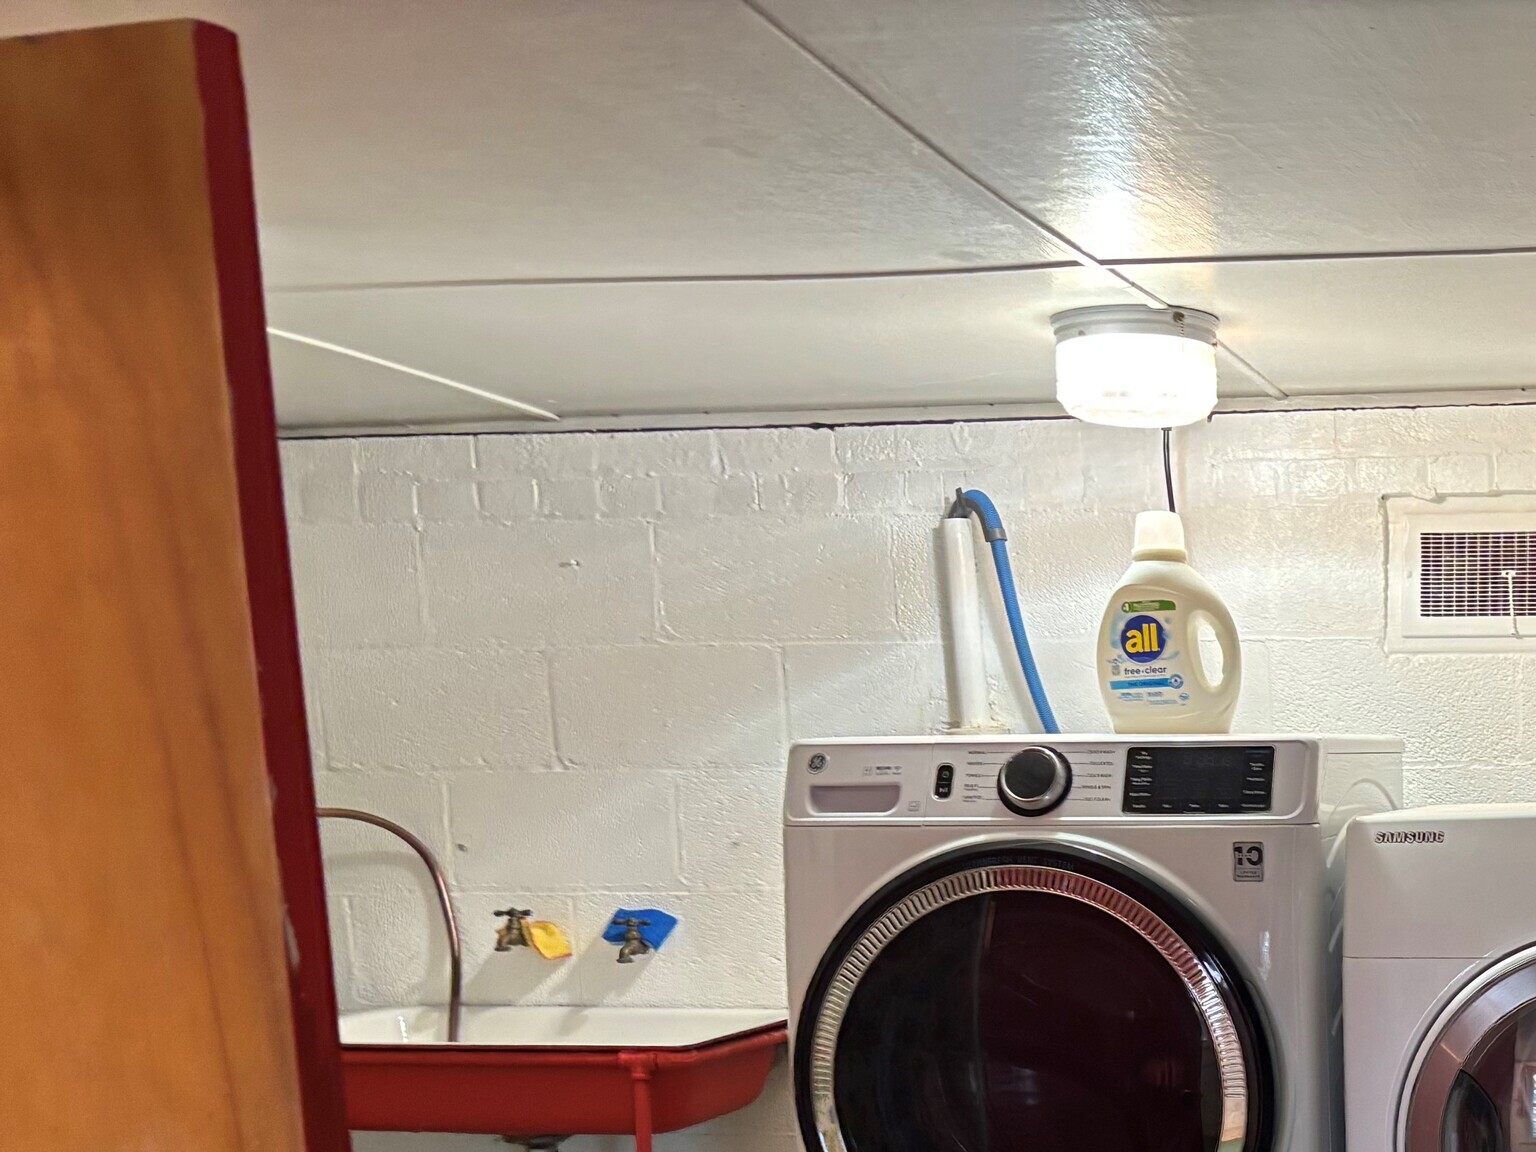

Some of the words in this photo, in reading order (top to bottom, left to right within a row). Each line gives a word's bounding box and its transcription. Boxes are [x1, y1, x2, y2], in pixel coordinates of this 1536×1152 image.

[1125, 622, 1159, 653] all
[1124, 667, 1141, 676] free
[1145, 665, 1167, 674] clear
[1374, 830, 1446, 844] SAMSUNG
